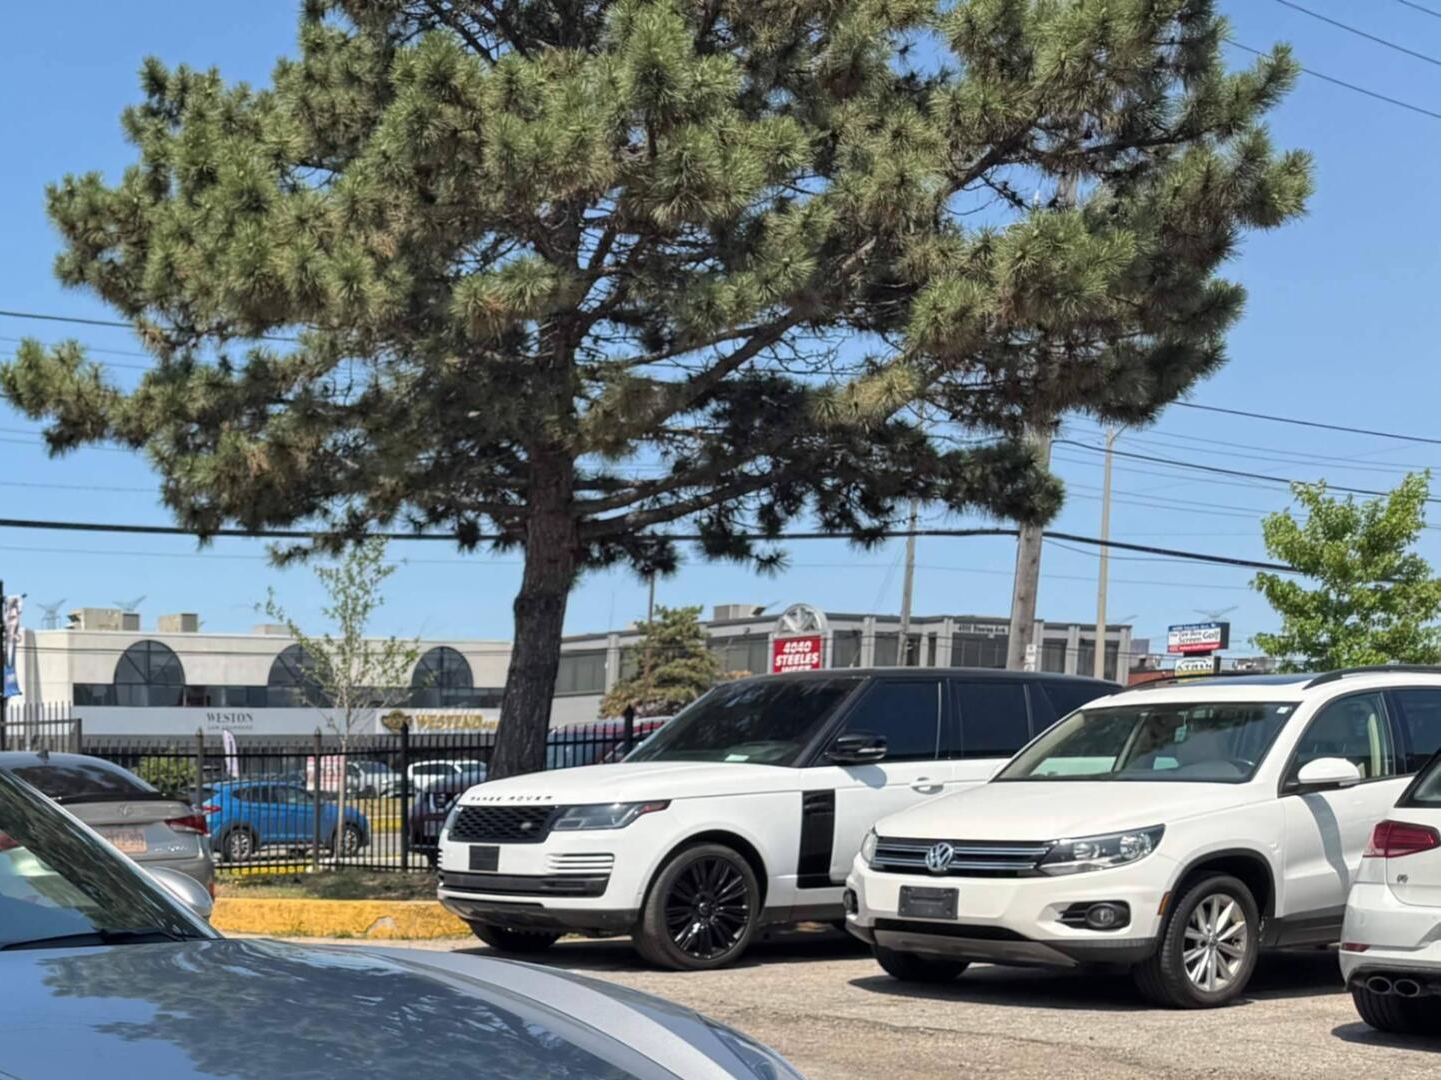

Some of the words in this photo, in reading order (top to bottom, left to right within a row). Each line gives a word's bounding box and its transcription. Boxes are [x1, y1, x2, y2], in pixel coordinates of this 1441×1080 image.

[783, 641, 812, 653] 4040
[775, 652, 819, 667] STEELES
[206, 712, 254, 724] WESTON
[415, 713, 483, 729] WESTEND
